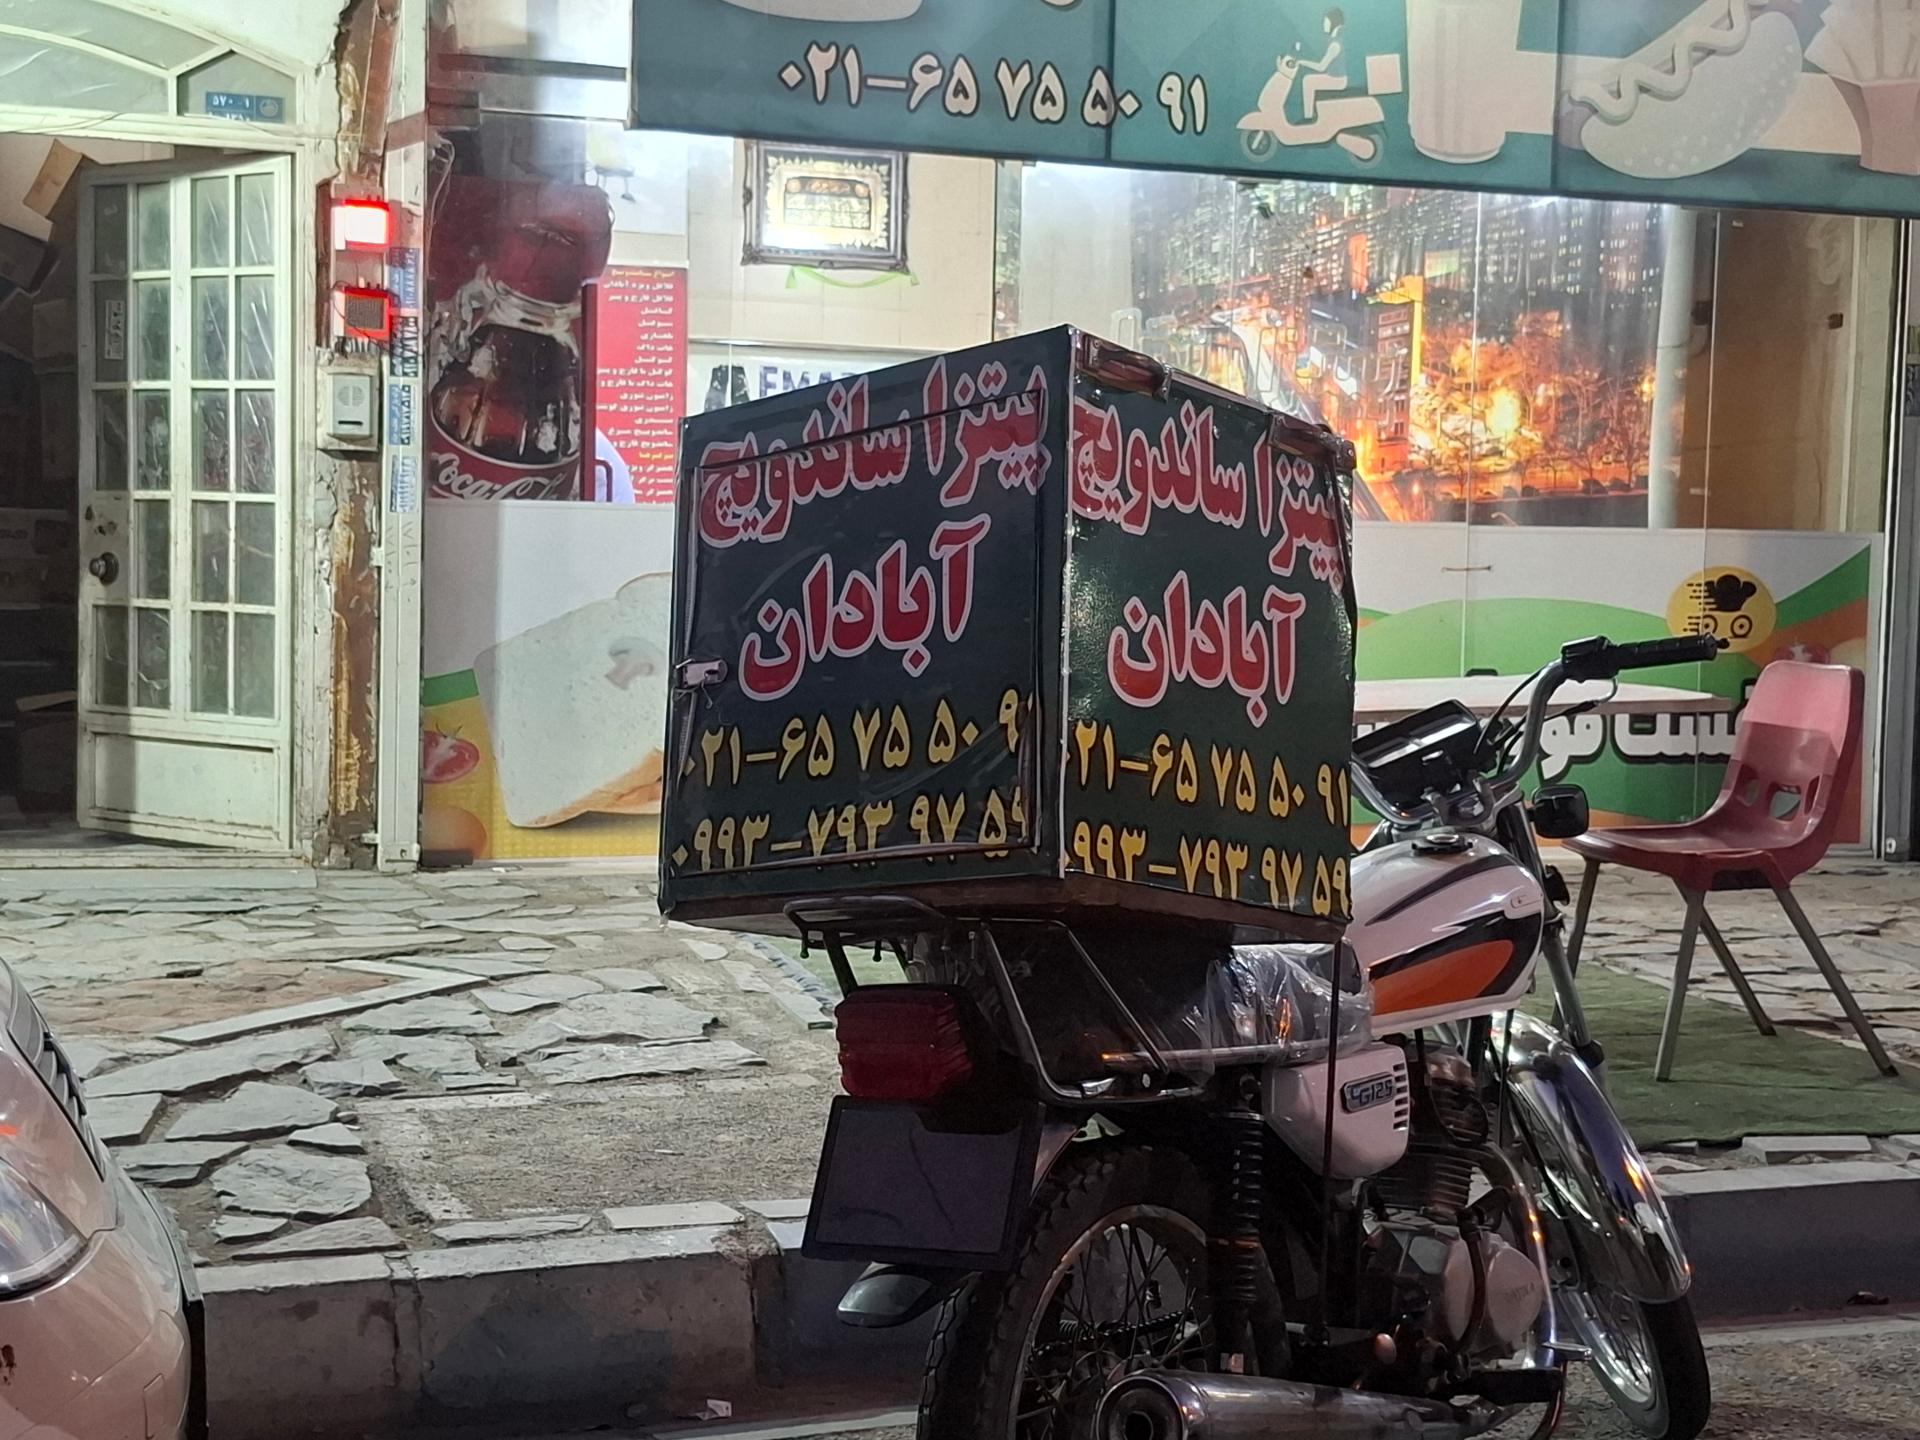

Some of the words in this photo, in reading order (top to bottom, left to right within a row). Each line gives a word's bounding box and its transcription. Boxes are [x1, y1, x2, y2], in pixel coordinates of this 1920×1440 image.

[995, 57, 1066, 124] ۷۵
[1081, 66, 1143, 127] ۵۰
[1156, 72, 1208, 135] ۹۱
[700, 374, 912, 549] ساندویچ
[923, 356, 1051, 508] پیتزا
[1072, 397, 1247, 536] ساندویچ
[1254, 430, 1347, 596] پیتزا
[738, 513, 992, 701] آبادان
[1107, 569, 1306, 728] آبادان
[851, 704, 911, 772] ۷۵
[928, 698, 981, 764] ۵۰
[1210, 743, 1257, 813] ۷۵
[1268, 755, 1306, 818] ۵۰
[1316, 763, 1349, 828] ۹۱
[909, 791, 965, 863] ۹۷
[1261, 846, 1303, 912] ۹۷
[1311, 855, 1350, 919] ۵۹
